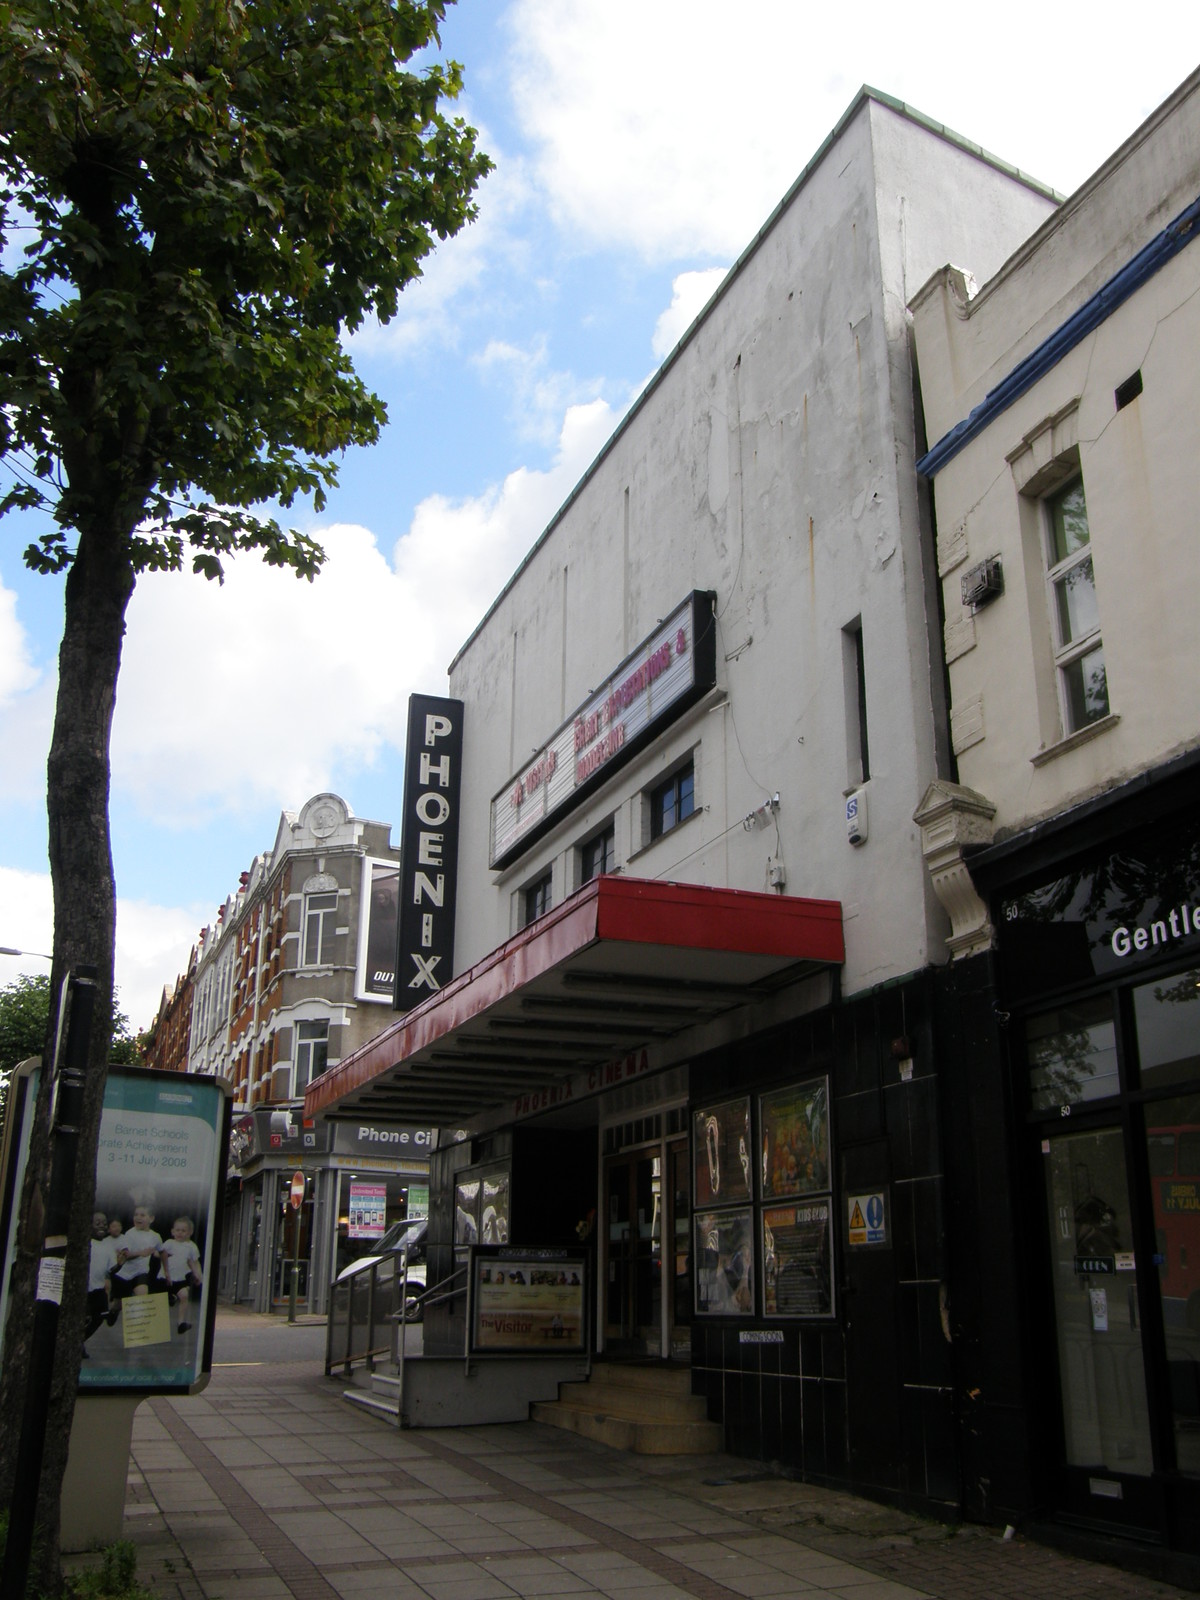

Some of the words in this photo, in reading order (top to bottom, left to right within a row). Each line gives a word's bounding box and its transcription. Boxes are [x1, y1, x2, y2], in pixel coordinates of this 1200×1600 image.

[407, 714, 453, 990] PHOENIX
[1006, 905, 1018, 921] 50
[514, 1081, 573, 1116] PHOENIX
[587, 1049, 649, 1090] CINEMA
[1060, 1106, 1071, 1117] 50
[115, 1124, 148, 1136] Barnet
[150, 1127, 190, 1139] Schools
[358, 1126, 410, 1144] Phone
[125, 1139, 188, 1154] Achievement
[108, 1152, 115, 1162] 3
[138, 1155, 158, 1168] July
[161, 1157, 187, 1168] 2008
[1082, 1260, 1108, 1273] OPEN
[494, 1319, 533, 1334] Visitor
